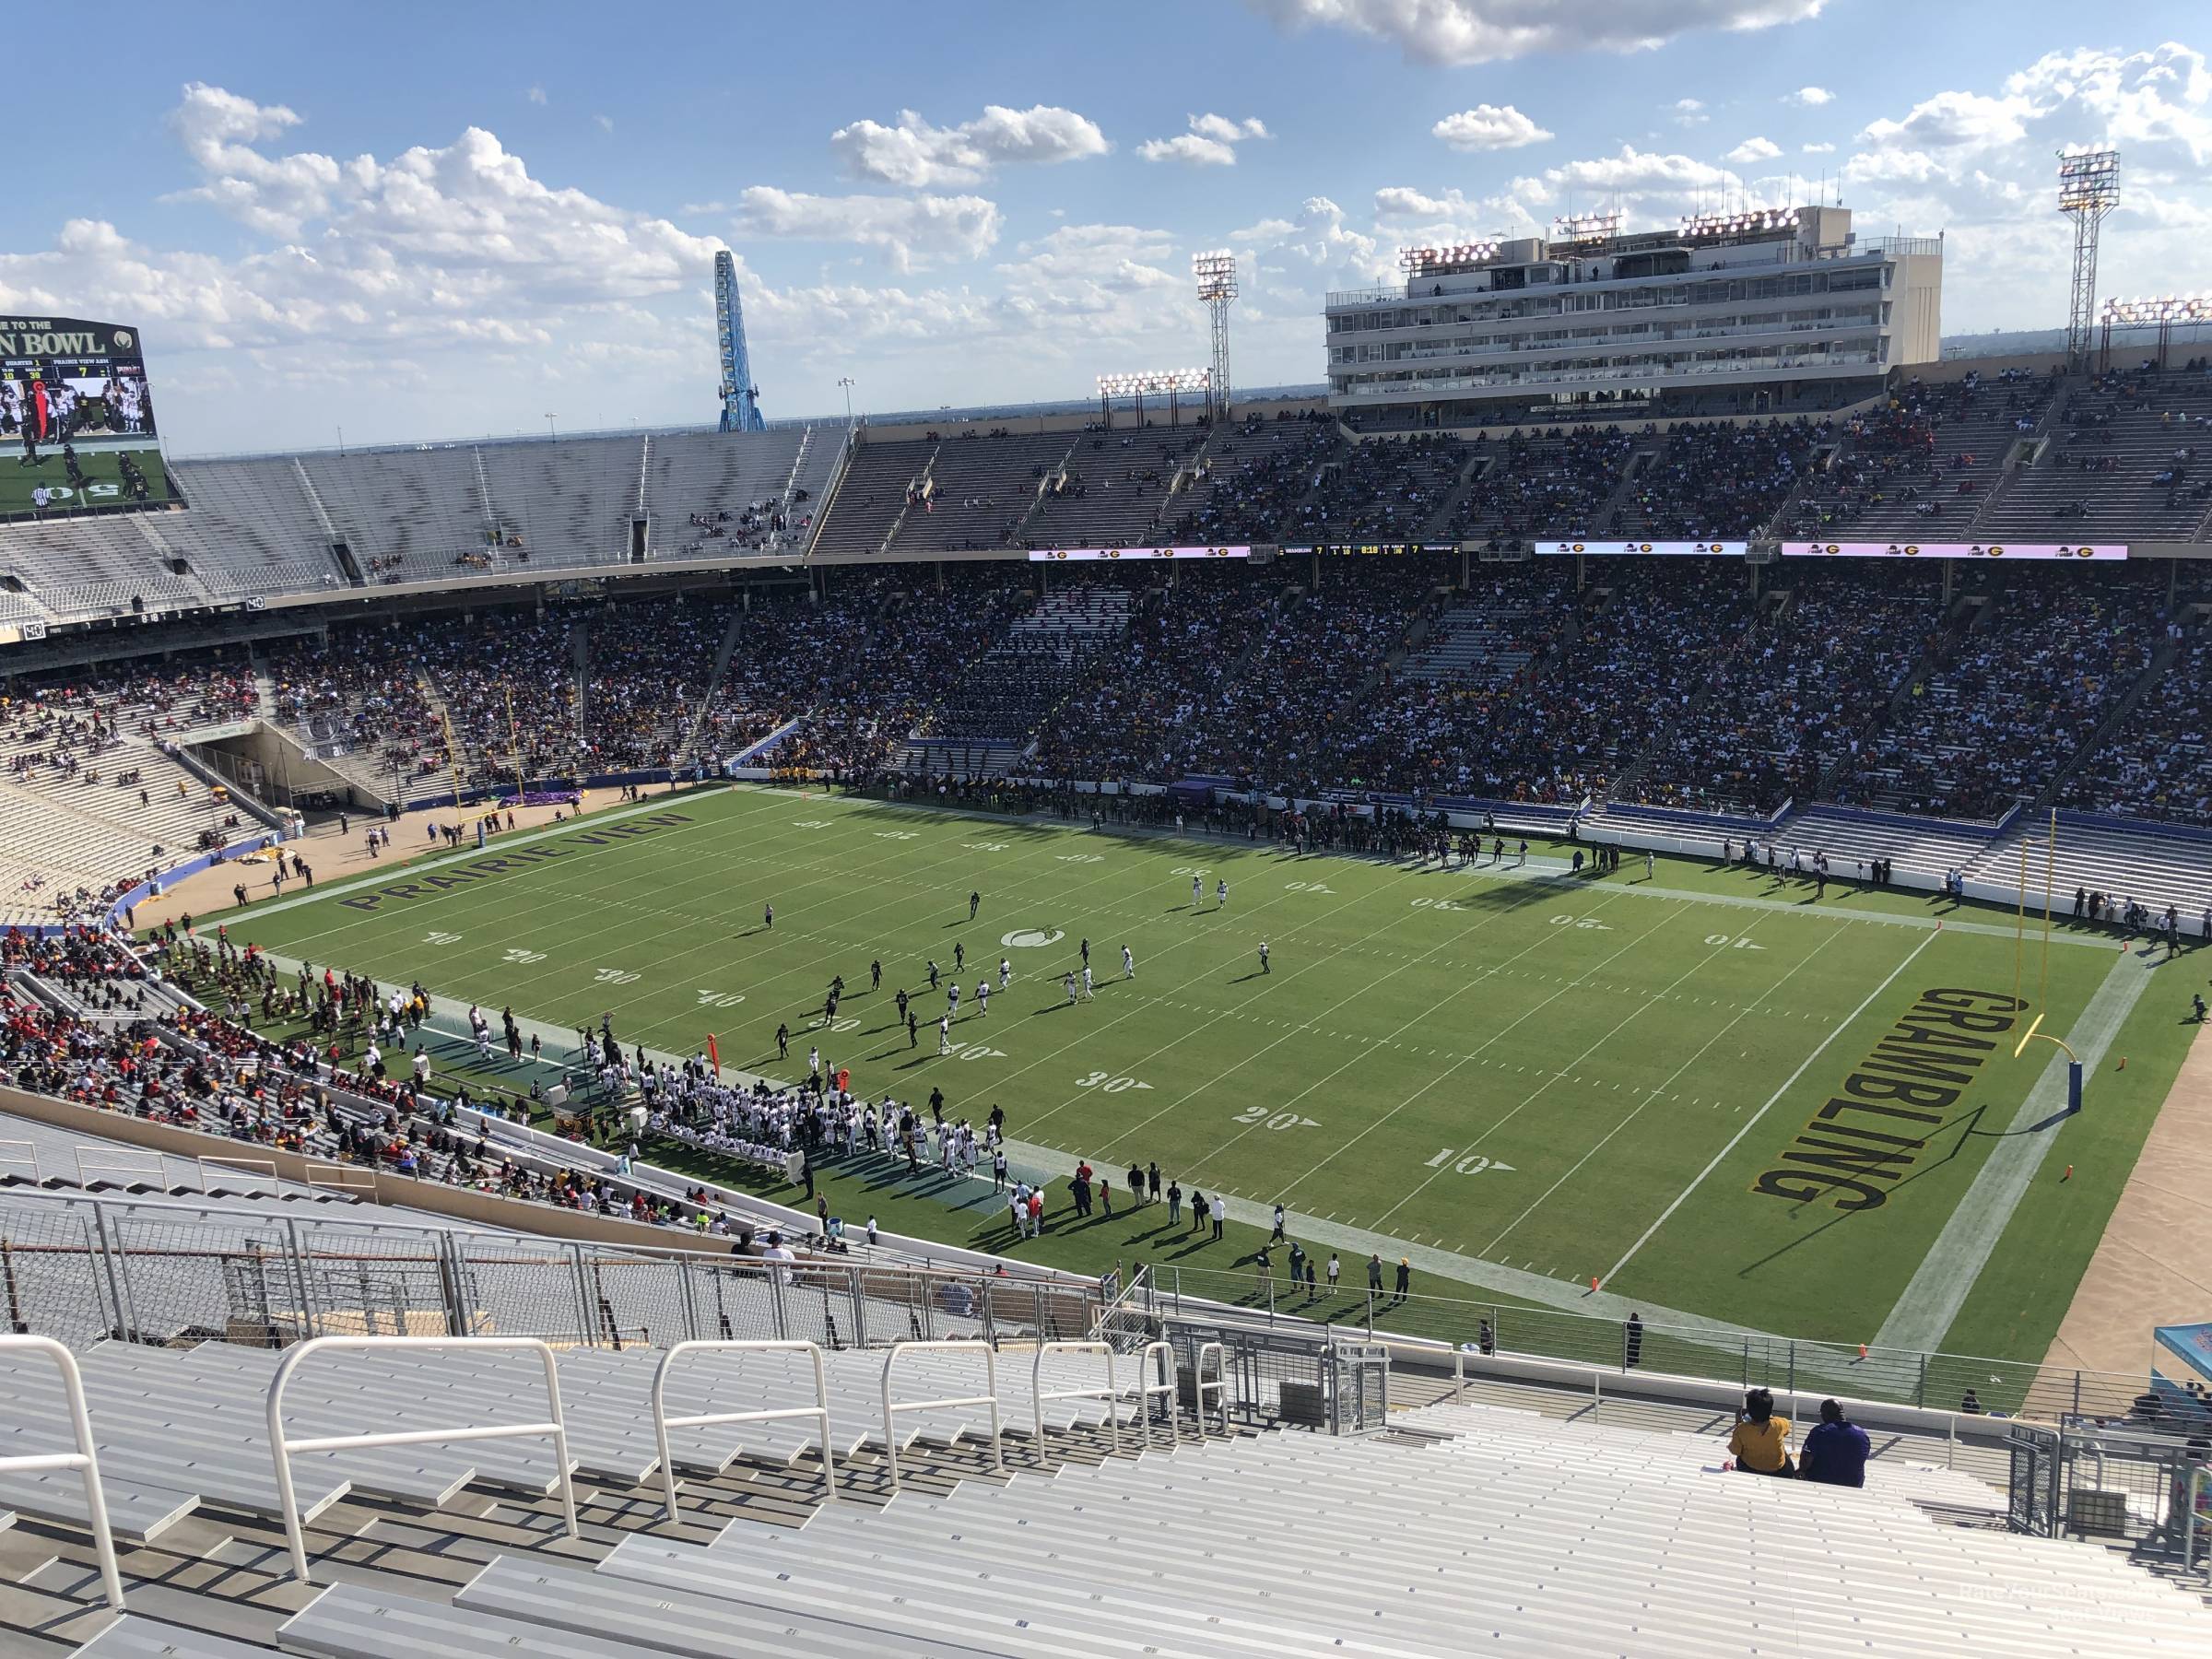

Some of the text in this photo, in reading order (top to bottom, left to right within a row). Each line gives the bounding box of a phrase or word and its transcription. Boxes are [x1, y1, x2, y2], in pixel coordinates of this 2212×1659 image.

[11, 321, 27, 330] TO
[29, 321, 52, 330] THE
[21, 332, 106, 355] BOWL
[78, 367, 87, 377] 7
[1412, 546, 1418, 554] 7
[248, 596, 265, 608] 40
[26, 624, 42, 636] 40
[971, 841, 1010, 852] 30
[335, 811, 697, 912] PRAIRIE VIEW
[1410, 898, 1456, 911] 30
[1550, 914, 1603, 929] 20
[421, 932, 463, 945] 10
[1704, 934, 1754, 948] 10
[501, 950, 547, 964] 20
[594, 970, 642, 984] 30
[697, 993, 745, 1007] 40
[1075, 1069, 1136, 1093] 30
[1750, 987, 2030, 1211] GRAMBLING
[1232, 1106, 1300, 1131] 20
[1423, 1147, 1490, 1175] 10
